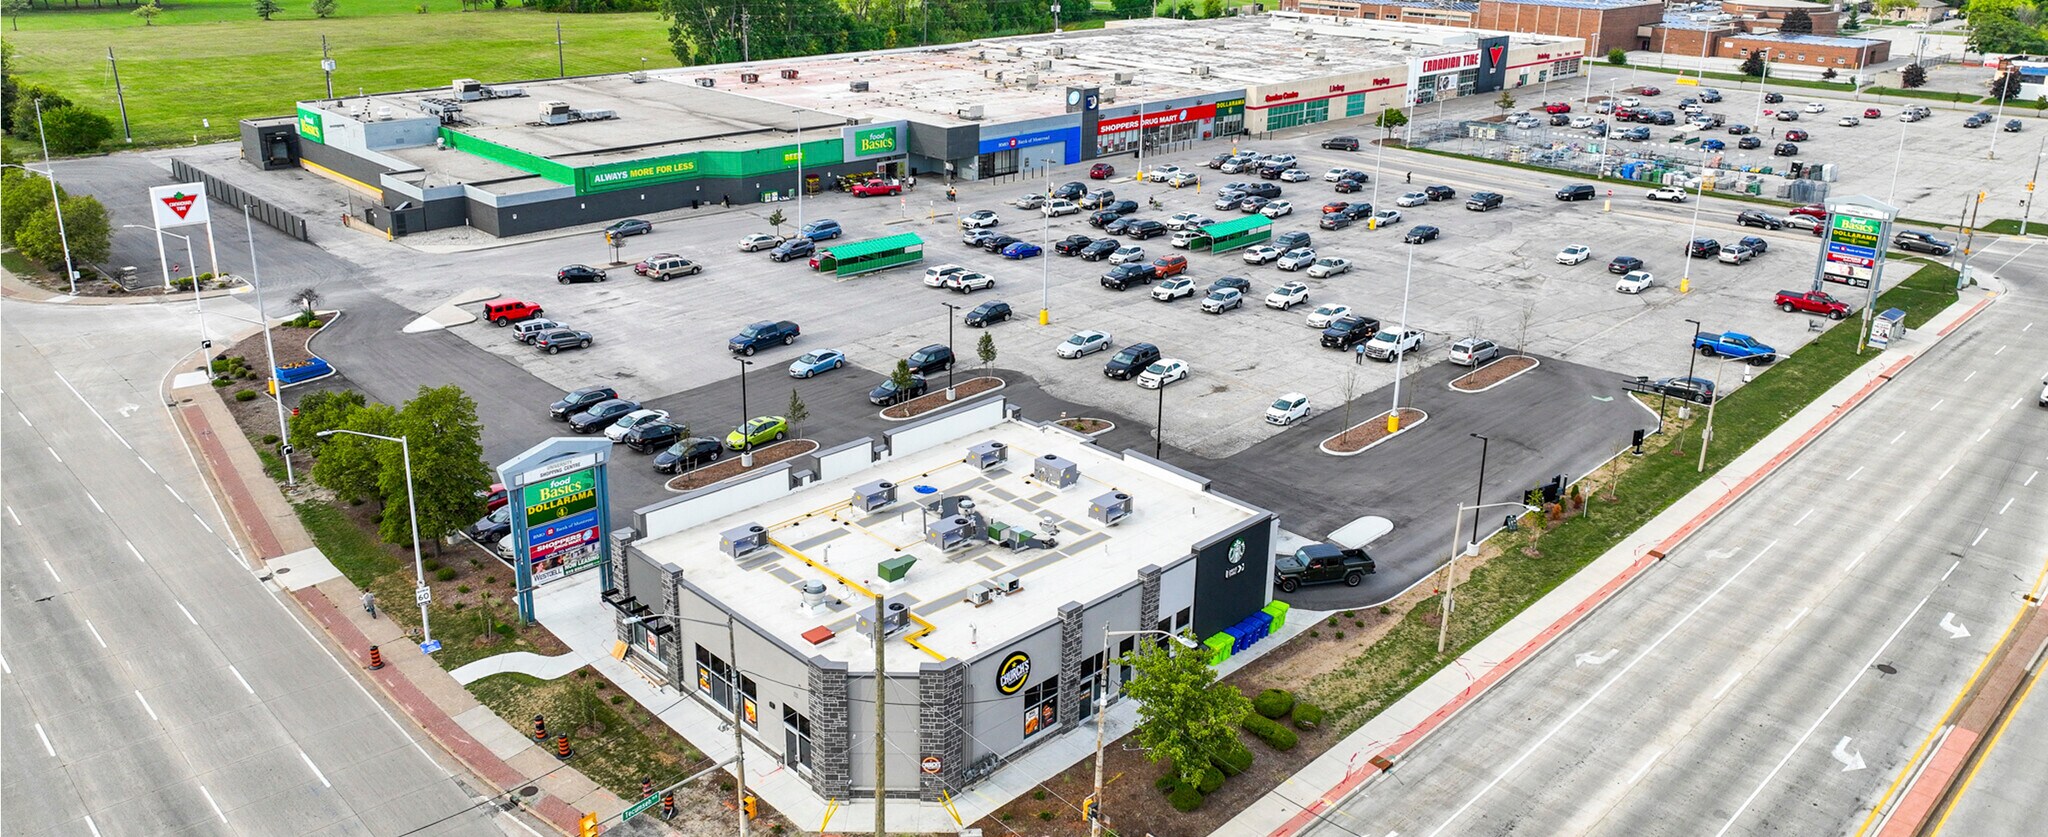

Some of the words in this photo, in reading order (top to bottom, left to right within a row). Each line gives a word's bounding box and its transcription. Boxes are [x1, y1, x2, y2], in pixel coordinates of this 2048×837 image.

[1423, 55, 1461, 73] CANADIAN
[1463, 53, 1479, 66] TIRE
[1329, 84, 1346, 93] Living
[1216, 99, 1245, 109] DOLLARAMA
[1100, 120, 1139, 133] SHOPPERS
[1141, 117, 1159, 127] DRUG
[1159, 114, 1178, 123] MART
[869, 132, 886, 141] food
[861, 137, 893, 151] Basics
[594, 171, 628, 183] ALWAYS
[630, 167, 654, 178] MORE
[656, 165, 672, 174] FOR
[674, 162, 694, 172] LESS
[1841, 219, 1874, 233] Basics
[1833, 229, 1878, 242] DOLLARAMA
[540, 468, 562, 477] SHOPPING
[563, 462, 581, 471] CENTRE
[550, 476, 571, 488] food
[540, 481, 582, 501] Basics
[528, 489, 594, 515] DOLLARAMA
[533, 532, 546, 540] BMO
[537, 533, 582, 552] SHOPPERS
[577, 554, 600, 565] LEASING
[418, 592, 430, 601] 60
[1000, 659, 1030, 687] CHURCH'S
[625, 799, 652, 819] Tecumseh
